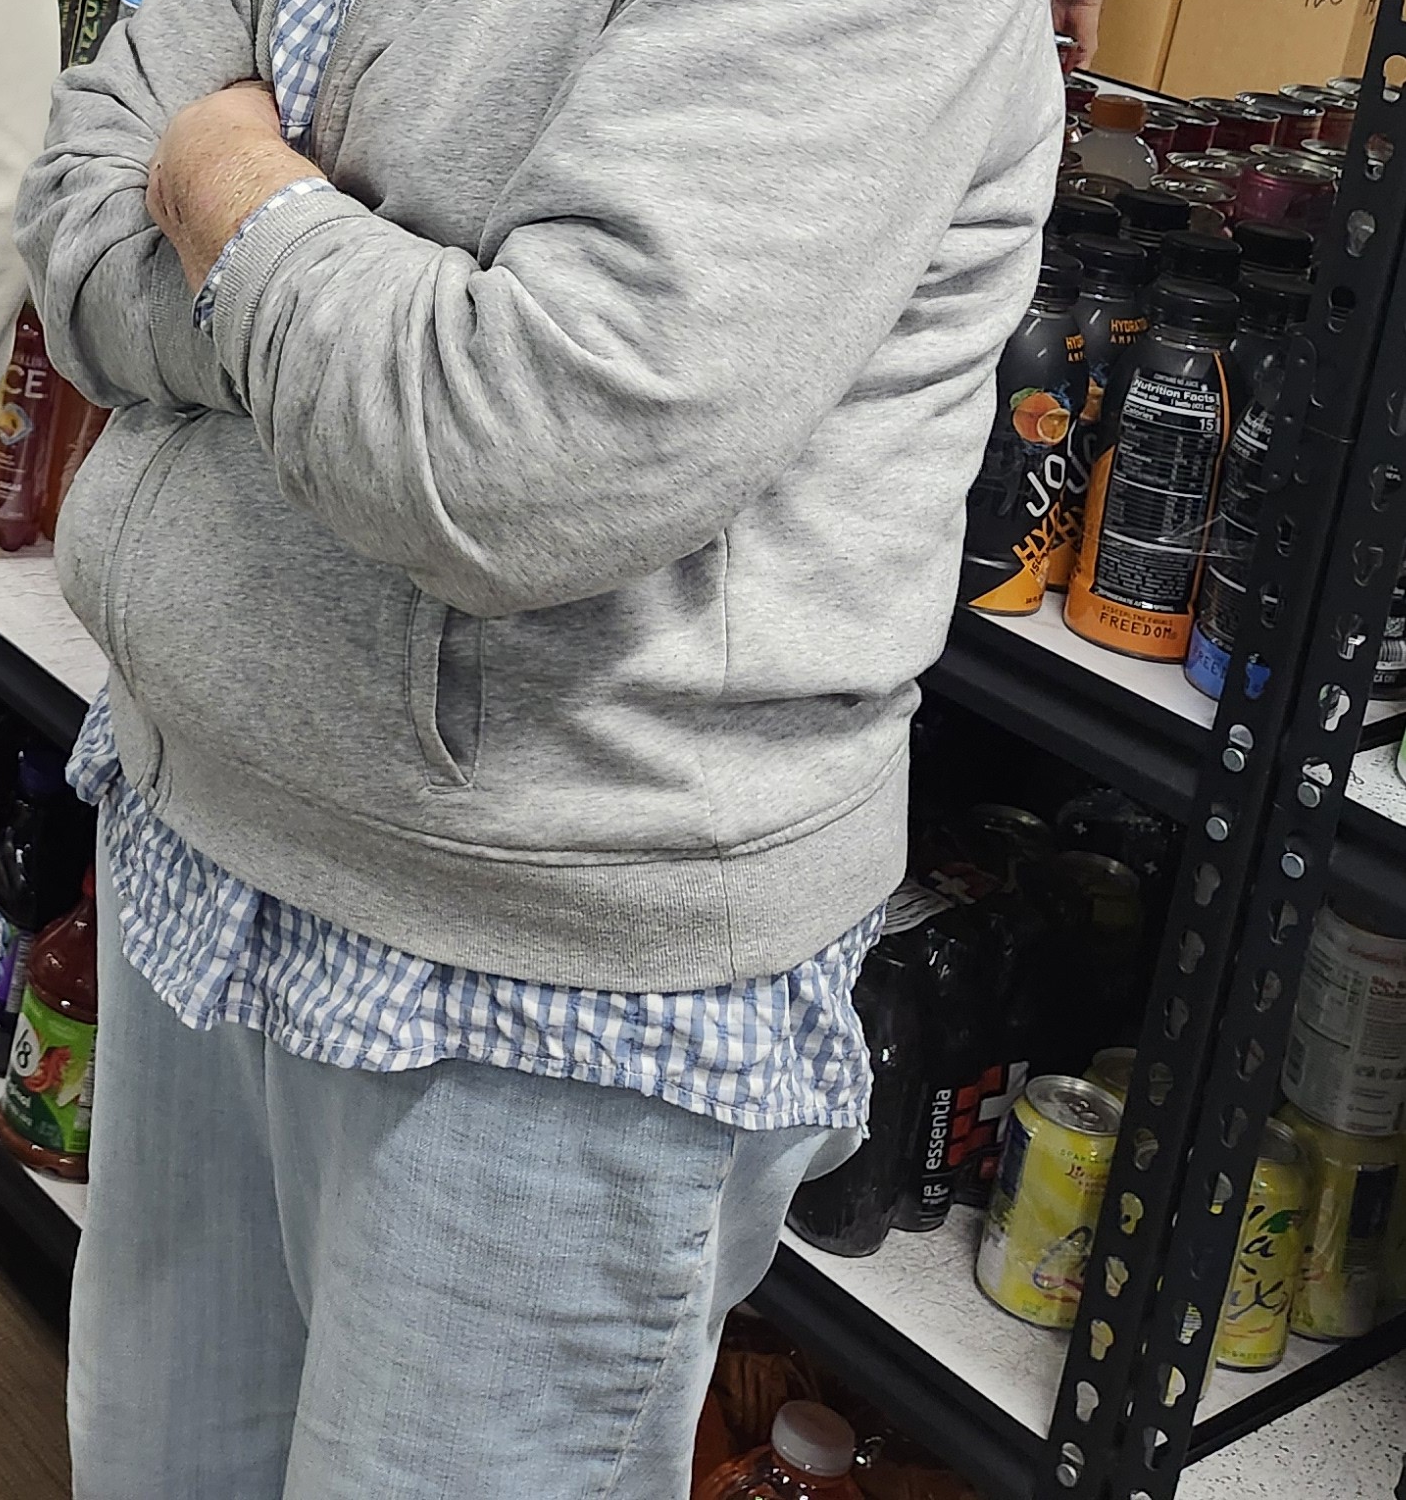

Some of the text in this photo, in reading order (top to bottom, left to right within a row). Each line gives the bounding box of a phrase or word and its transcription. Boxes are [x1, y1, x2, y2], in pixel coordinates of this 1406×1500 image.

[1133, 379, 1215, 403] Nutrition Facts
[1123, 404, 1214, 431] Calories 15
[1099, 612, 1173, 640] FREEDOM
[925, 1089, 952, 1170] essentia
